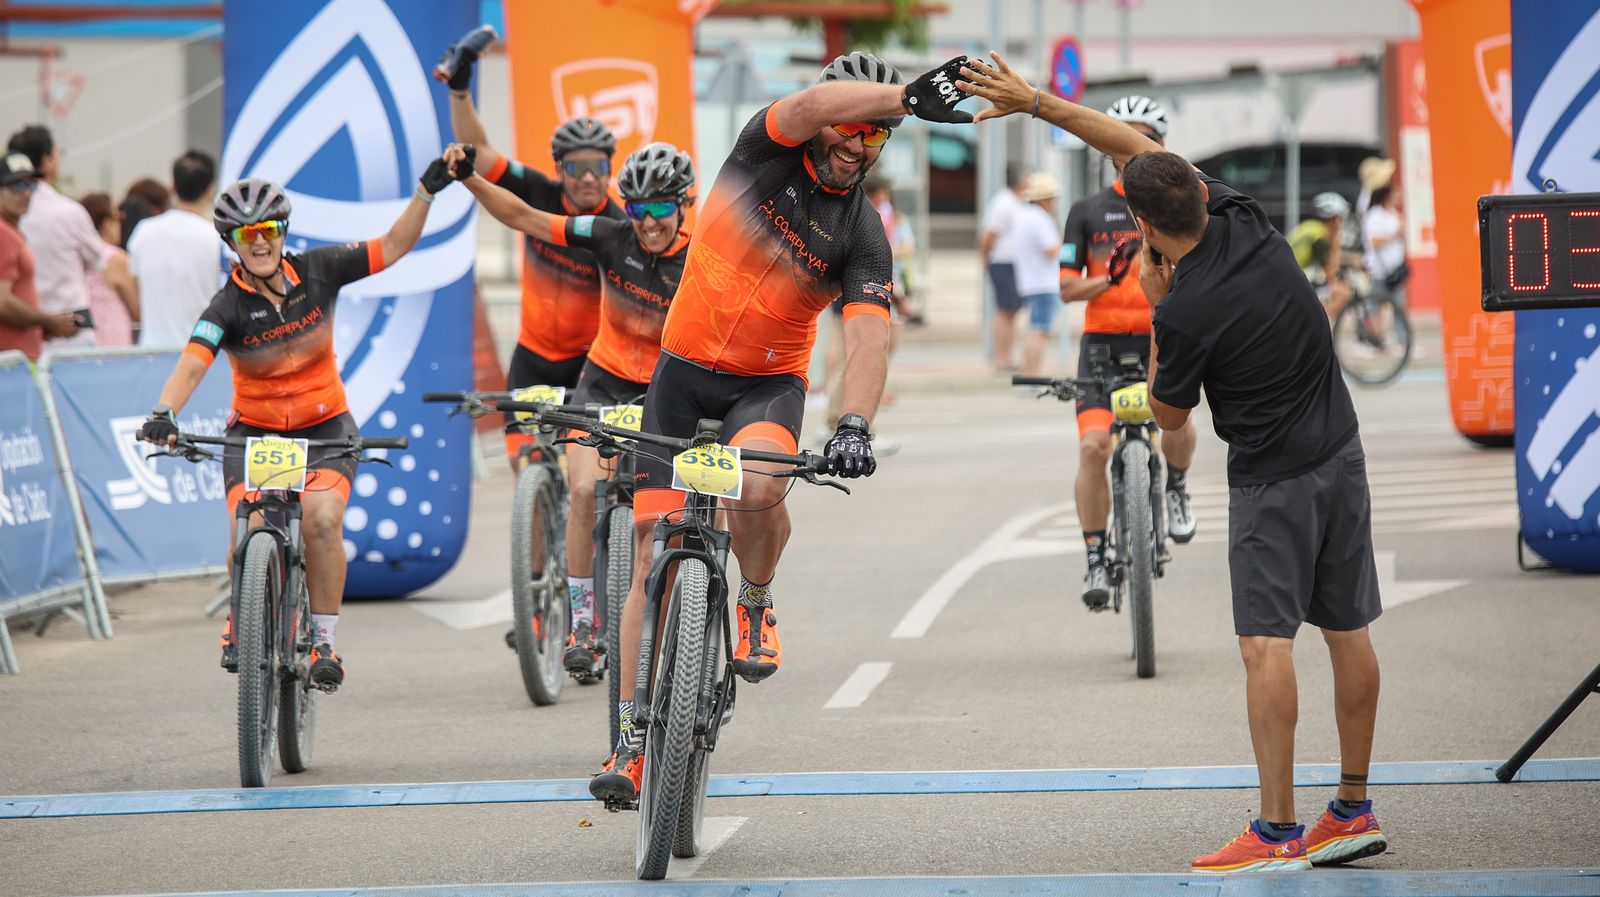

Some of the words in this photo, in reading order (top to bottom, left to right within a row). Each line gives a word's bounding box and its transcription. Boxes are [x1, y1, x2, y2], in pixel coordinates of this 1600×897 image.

[624, 280, 672, 306] CORREPLA
[253, 450, 298, 467] 551
[681, 451, 735, 471] 536
[635, 639, 652, 689] ROCKSHOX
